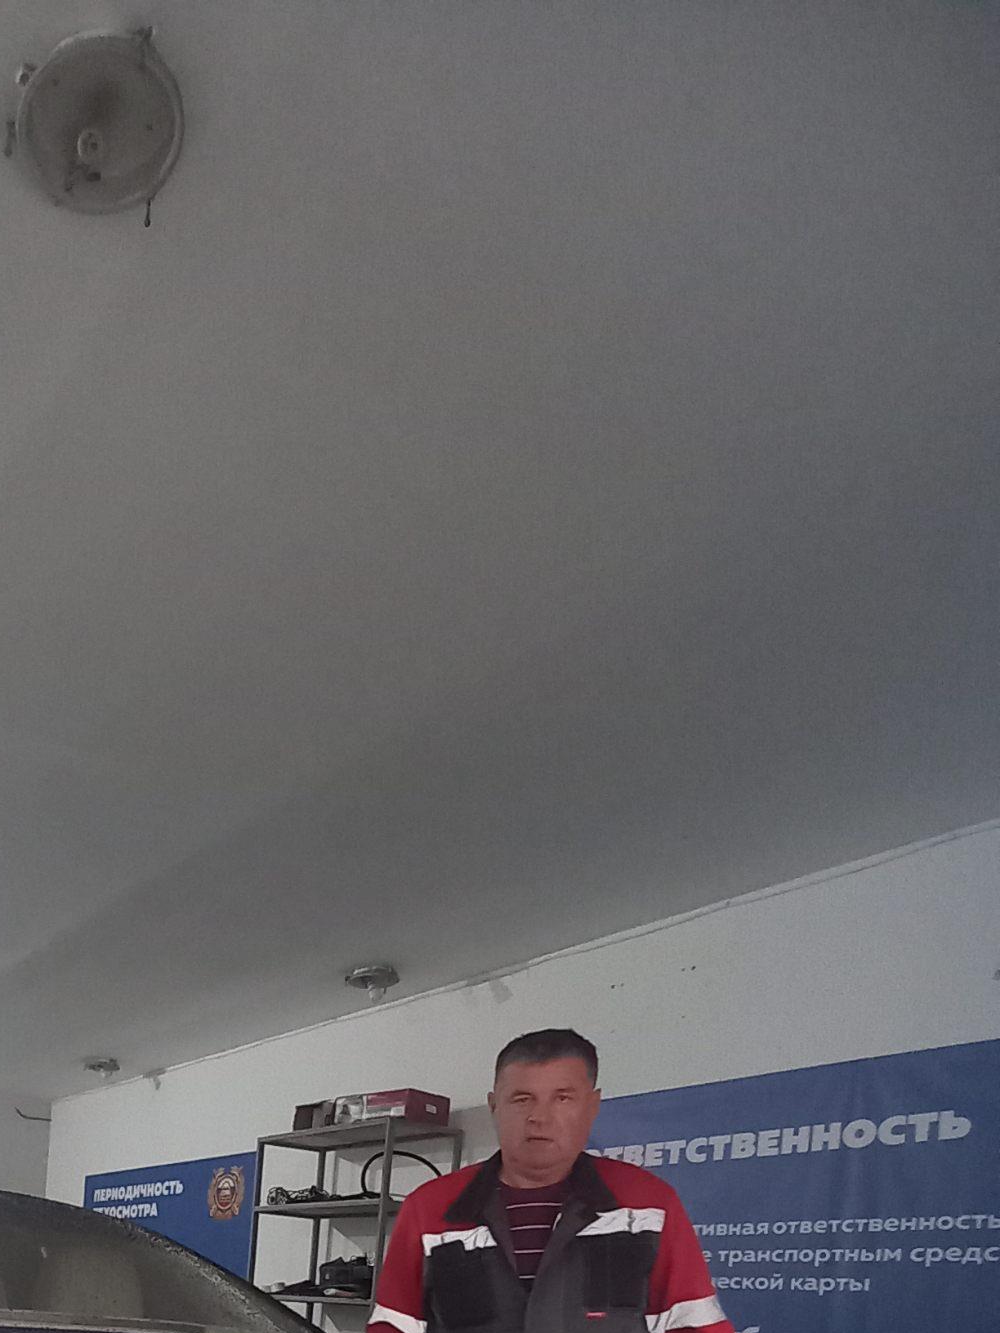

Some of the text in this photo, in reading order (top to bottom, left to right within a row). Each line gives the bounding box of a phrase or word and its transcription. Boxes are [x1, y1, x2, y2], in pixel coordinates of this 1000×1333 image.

[93, 1179, 184, 1203] ПЕРИОДИЧНОСТЬ
[92, 1202, 159, 1219] ХОСМОТРА
[772, 1213, 1000, 1236] ответственность
[718, 1247, 902, 1269] транспортным
[711, 1272, 871, 1296] еской карты
